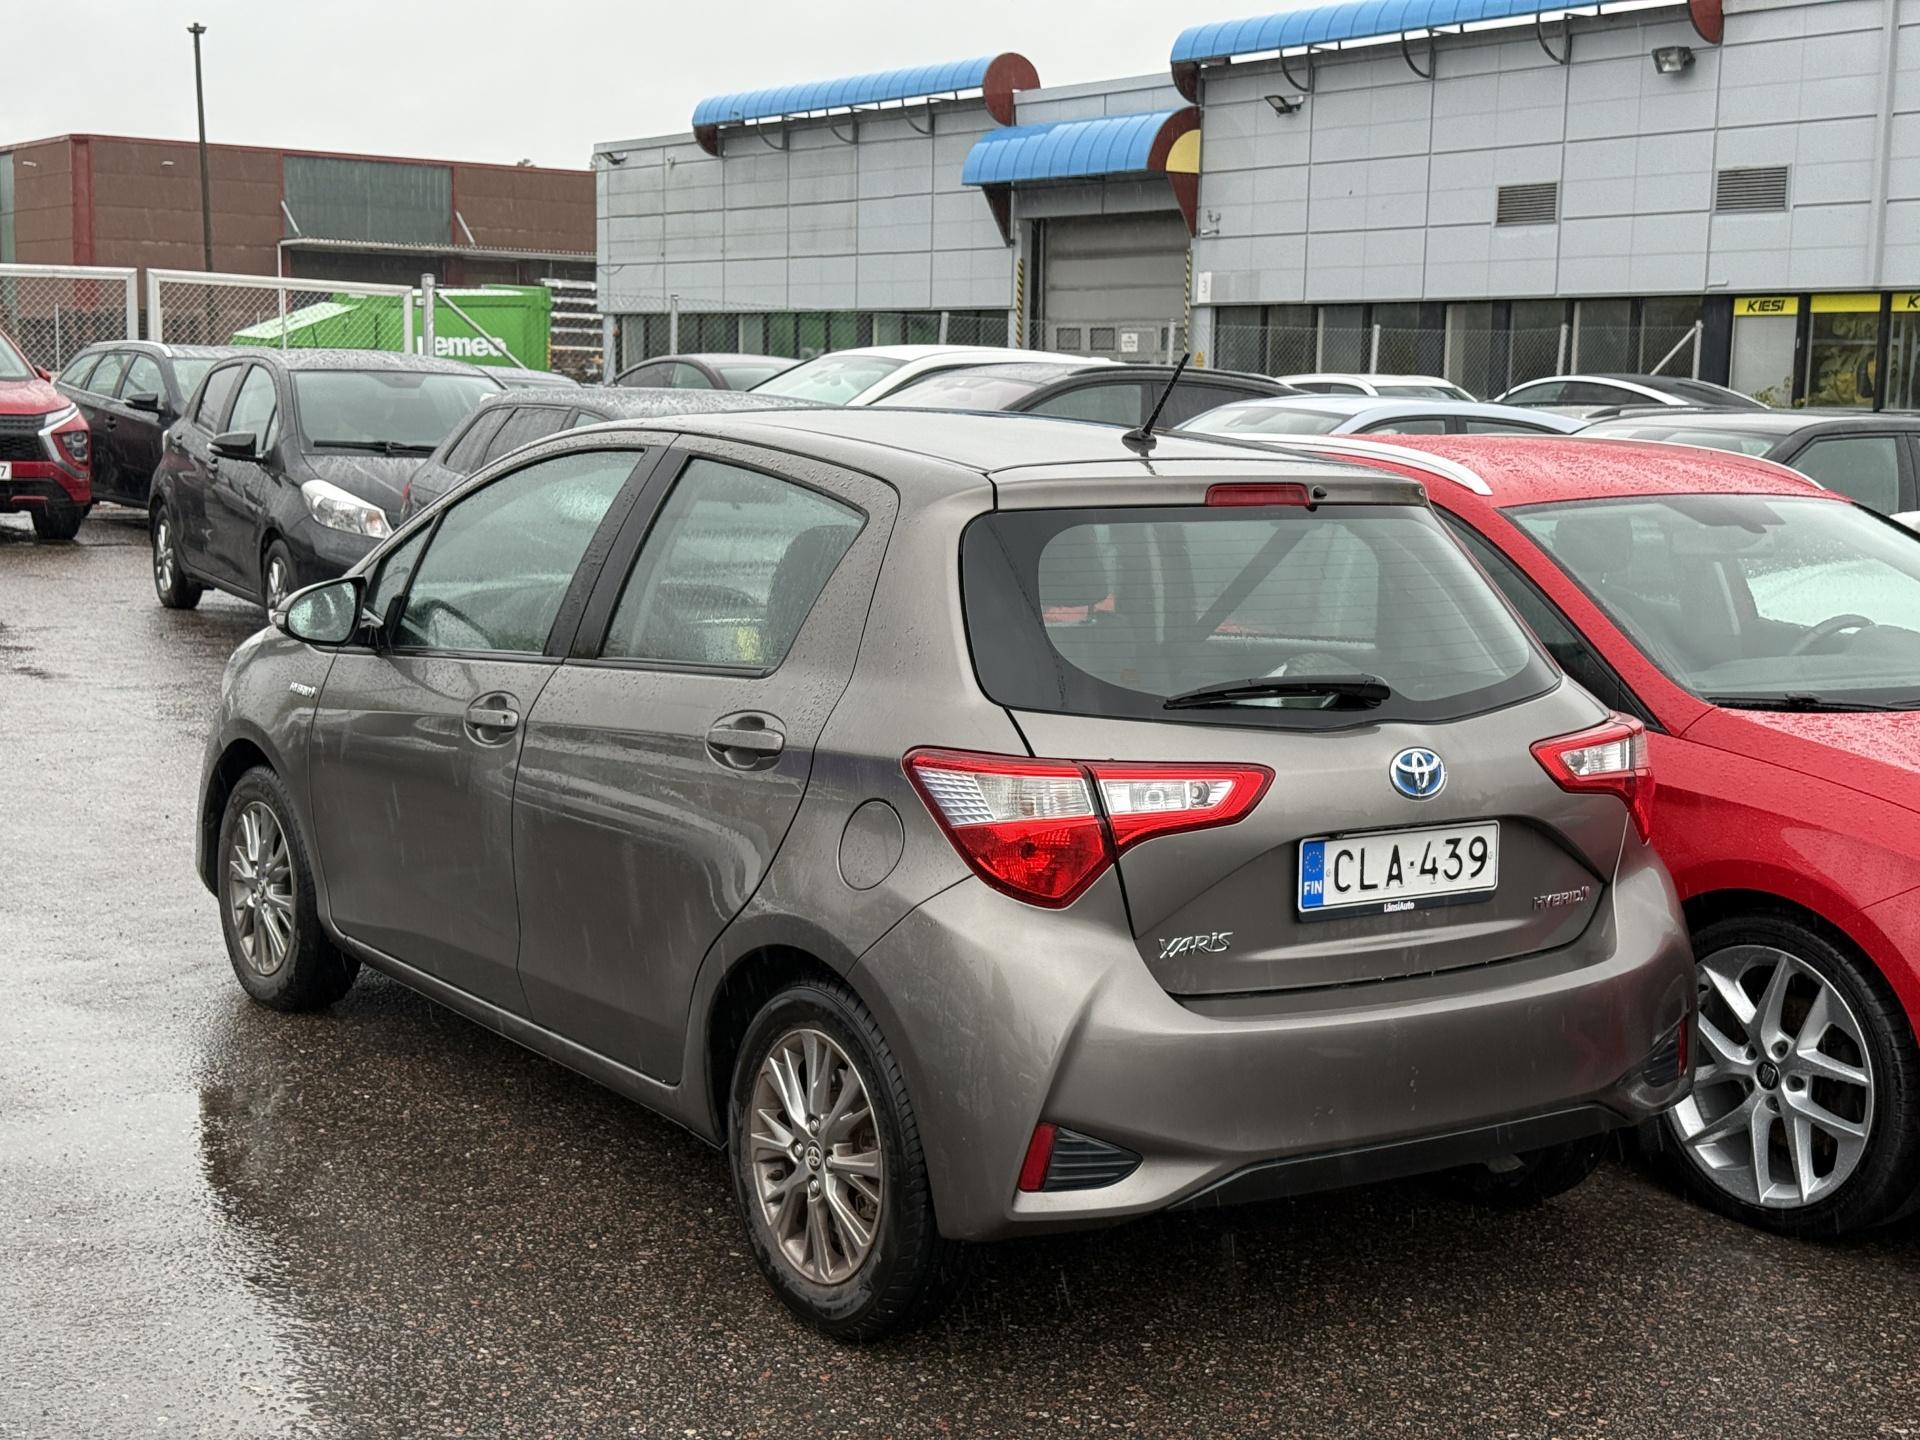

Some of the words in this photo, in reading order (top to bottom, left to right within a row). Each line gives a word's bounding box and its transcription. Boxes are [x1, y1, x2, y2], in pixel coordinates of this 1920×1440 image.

[1746, 299, 1785, 312] KIESI
[1333, 836, 1488, 892] CLA-439
[1303, 880, 1323, 896] FIN
[1532, 889, 1581, 911] HYBRID
